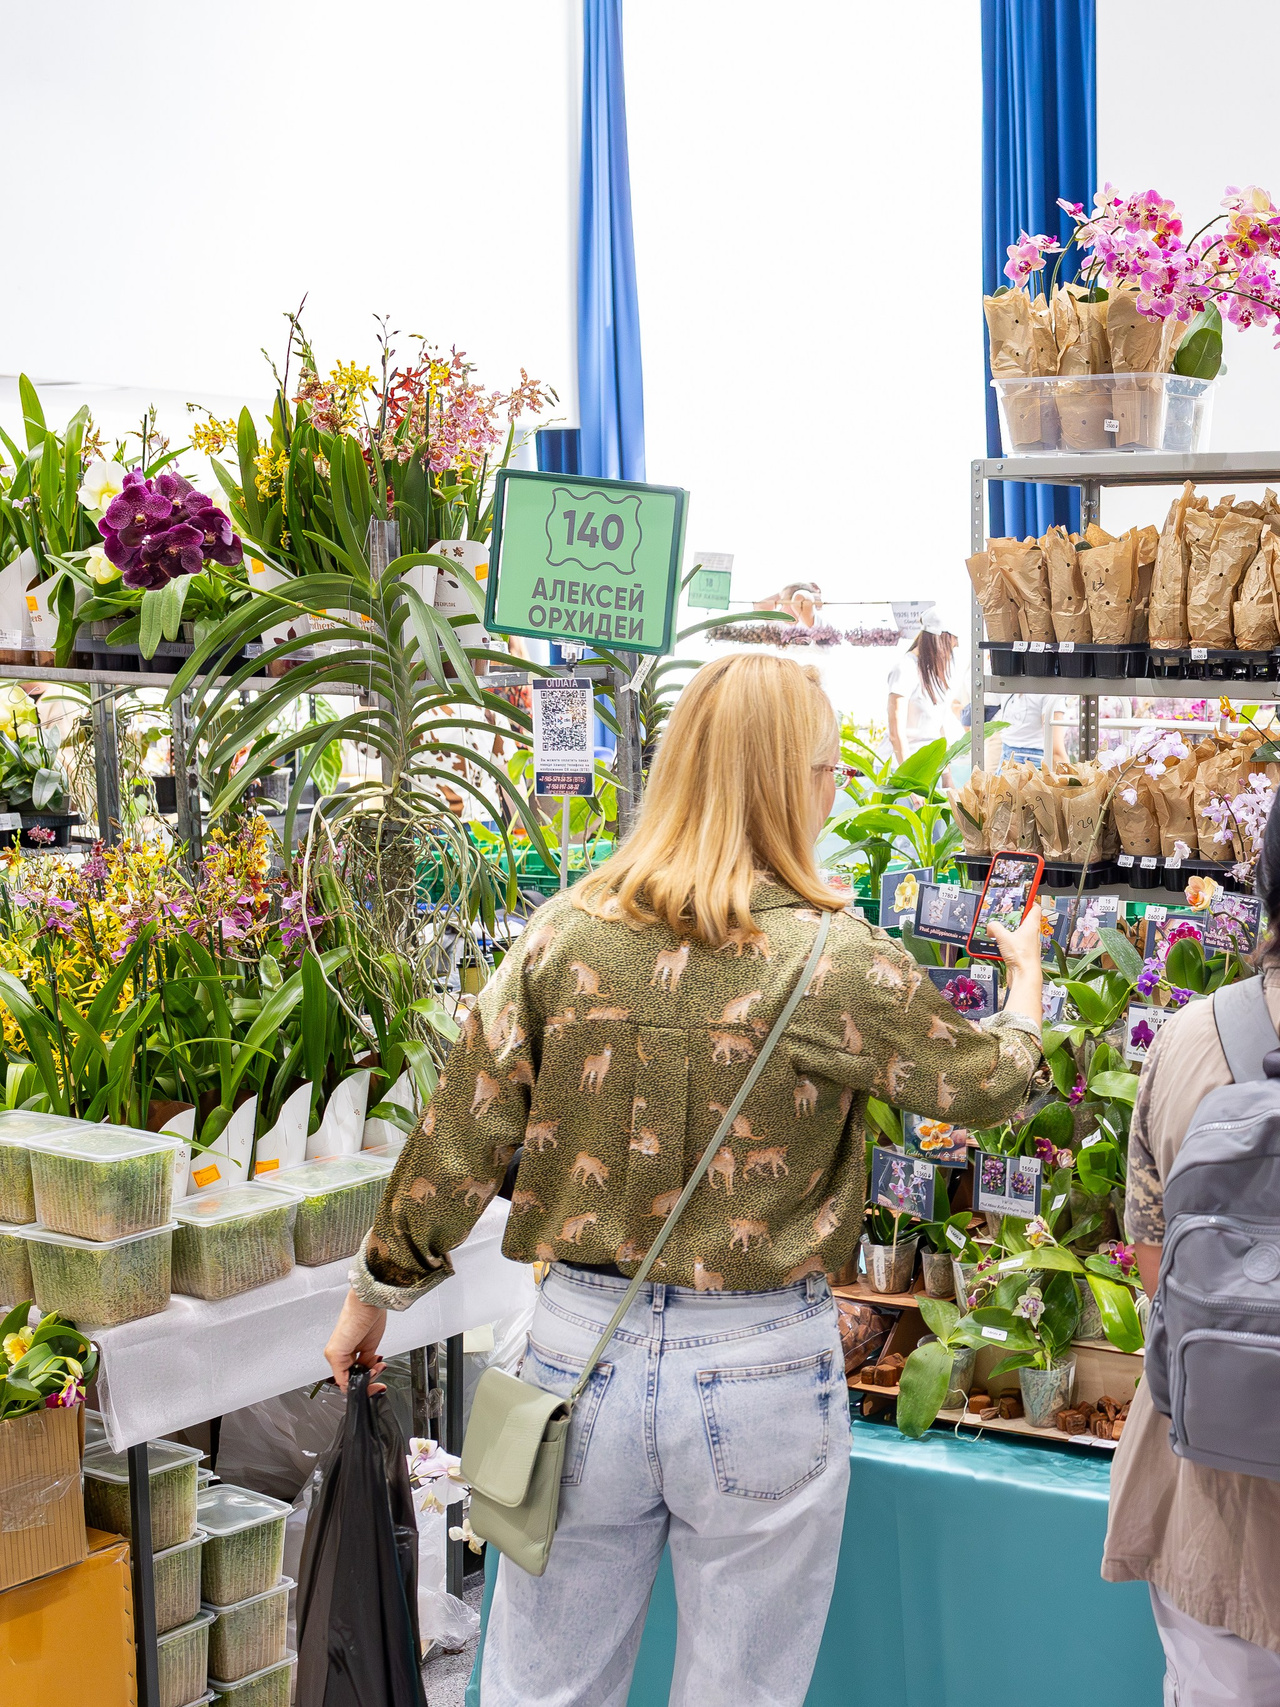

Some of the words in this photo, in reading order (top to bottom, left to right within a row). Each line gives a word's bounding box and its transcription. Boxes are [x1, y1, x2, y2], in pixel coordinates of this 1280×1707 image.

[563, 510, 624, 550] 140
[531, 577, 645, 612] АЛЕКСЕЙ
[528, 604, 645, 641] ОРХИДЕИ
[546, 679, 578, 688] ОПЛАТА
[916, 1170, 927, 1178] 1360
